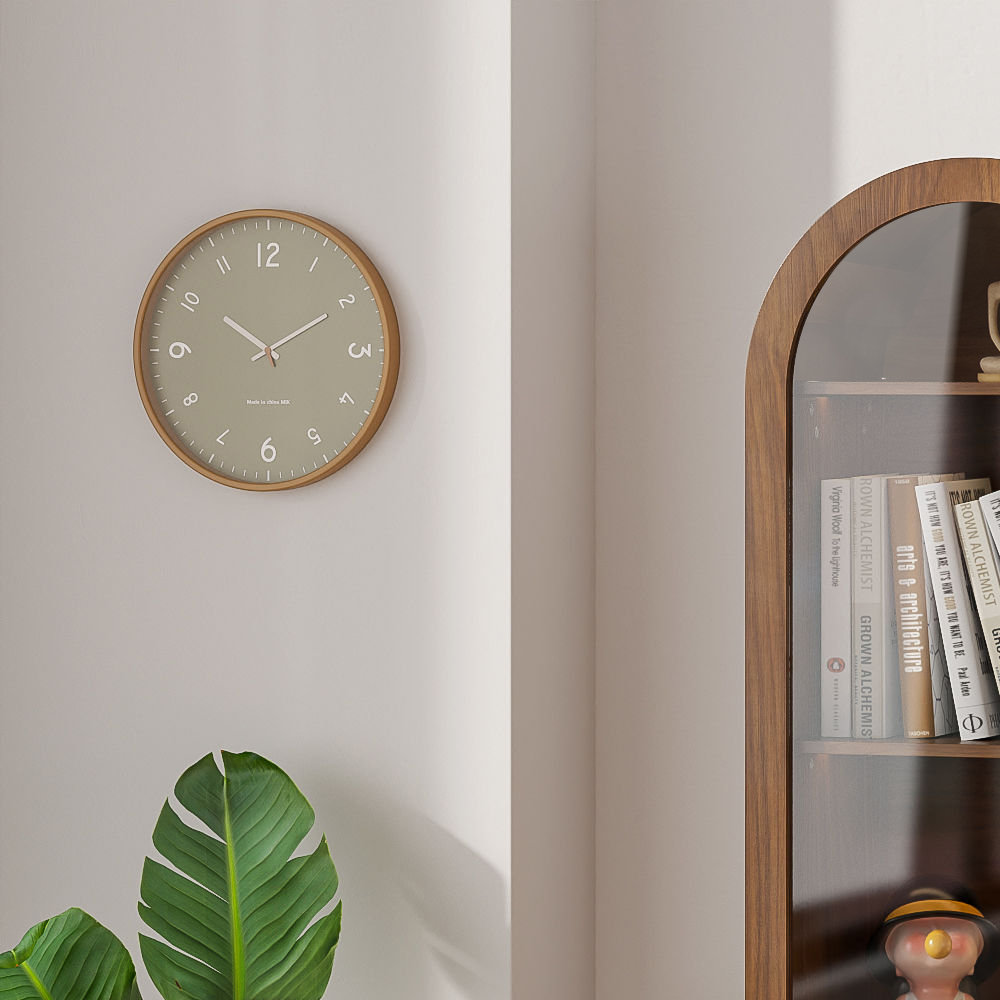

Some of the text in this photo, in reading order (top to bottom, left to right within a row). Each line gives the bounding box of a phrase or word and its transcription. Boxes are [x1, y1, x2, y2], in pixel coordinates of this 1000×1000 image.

[257, 242, 280, 268] 12
[309, 256, 319, 273] 1
[180, 291, 200, 312] 10
[338, 294, 356, 309] 2
[168, 341, 192, 359] 9
[348, 342, 372, 359] 3
[183, 392, 199, 407] 8
[338, 391, 355, 405] 4
[216, 428, 230, 445] 7
[307, 427, 322, 446] 5
[260, 437, 277, 463] 6
[828, 486, 842, 513] Virginia
[831, 514, 842, 536] Woolf
[860, 523, 873, 592] ALCHEMIST
[896, 545, 918, 571] arts
[970, 543, 997, 606] ALCHEMIST
[899, 593, 924, 673] architecture
[860, 615, 873, 739] GROWN ALCHEMIS
[957, 667, 972, 697] Paul Arden
